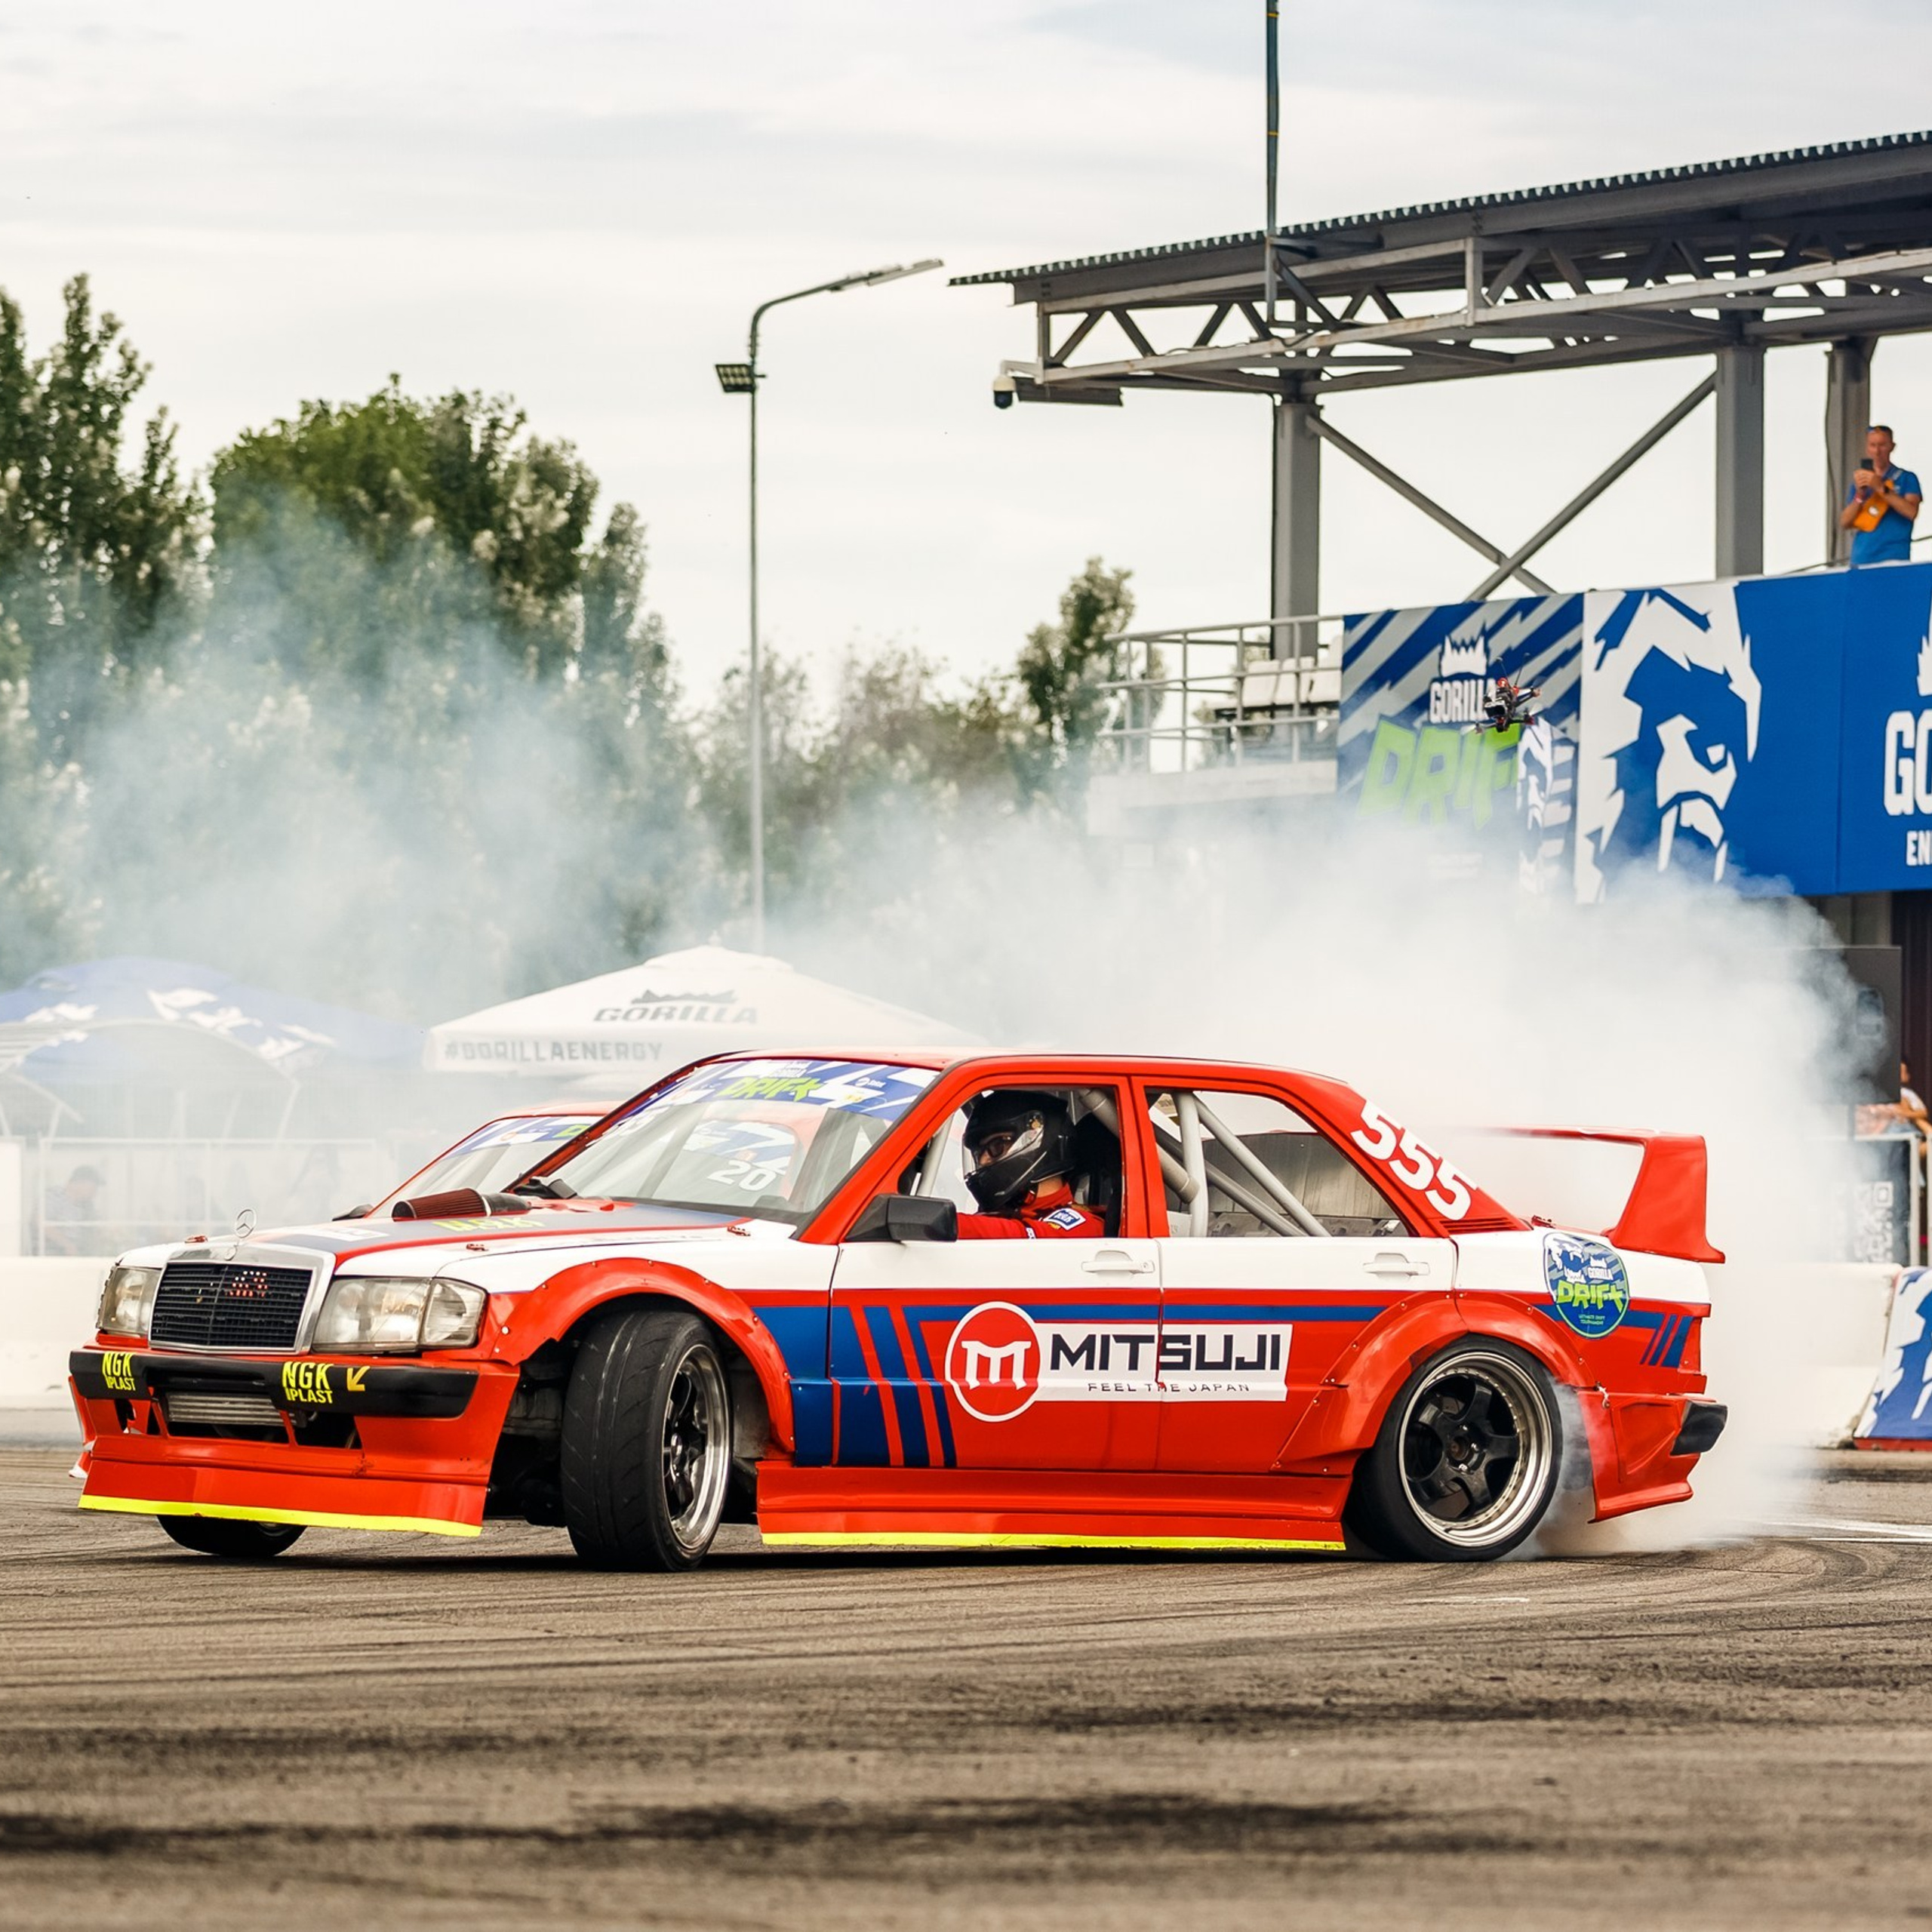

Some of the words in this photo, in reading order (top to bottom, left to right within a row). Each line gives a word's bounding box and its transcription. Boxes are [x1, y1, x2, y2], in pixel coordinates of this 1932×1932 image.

[1358, 719, 1520, 829] DRIF
[592, 1007, 758, 1024] GORILLA
[707, 1159, 777, 1191] 20
[1350, 1100, 1478, 1220] 555
[1557, 1279, 1624, 1313] DRIFT
[102, 1352, 137, 1377] NGK
[1051, 1334, 1281, 1371] MITSUJI
[282, 1361, 334, 1390] NGK
[1088, 1383, 1137, 1392] FEEL
[1189, 1383, 1250, 1392] JAPAN
